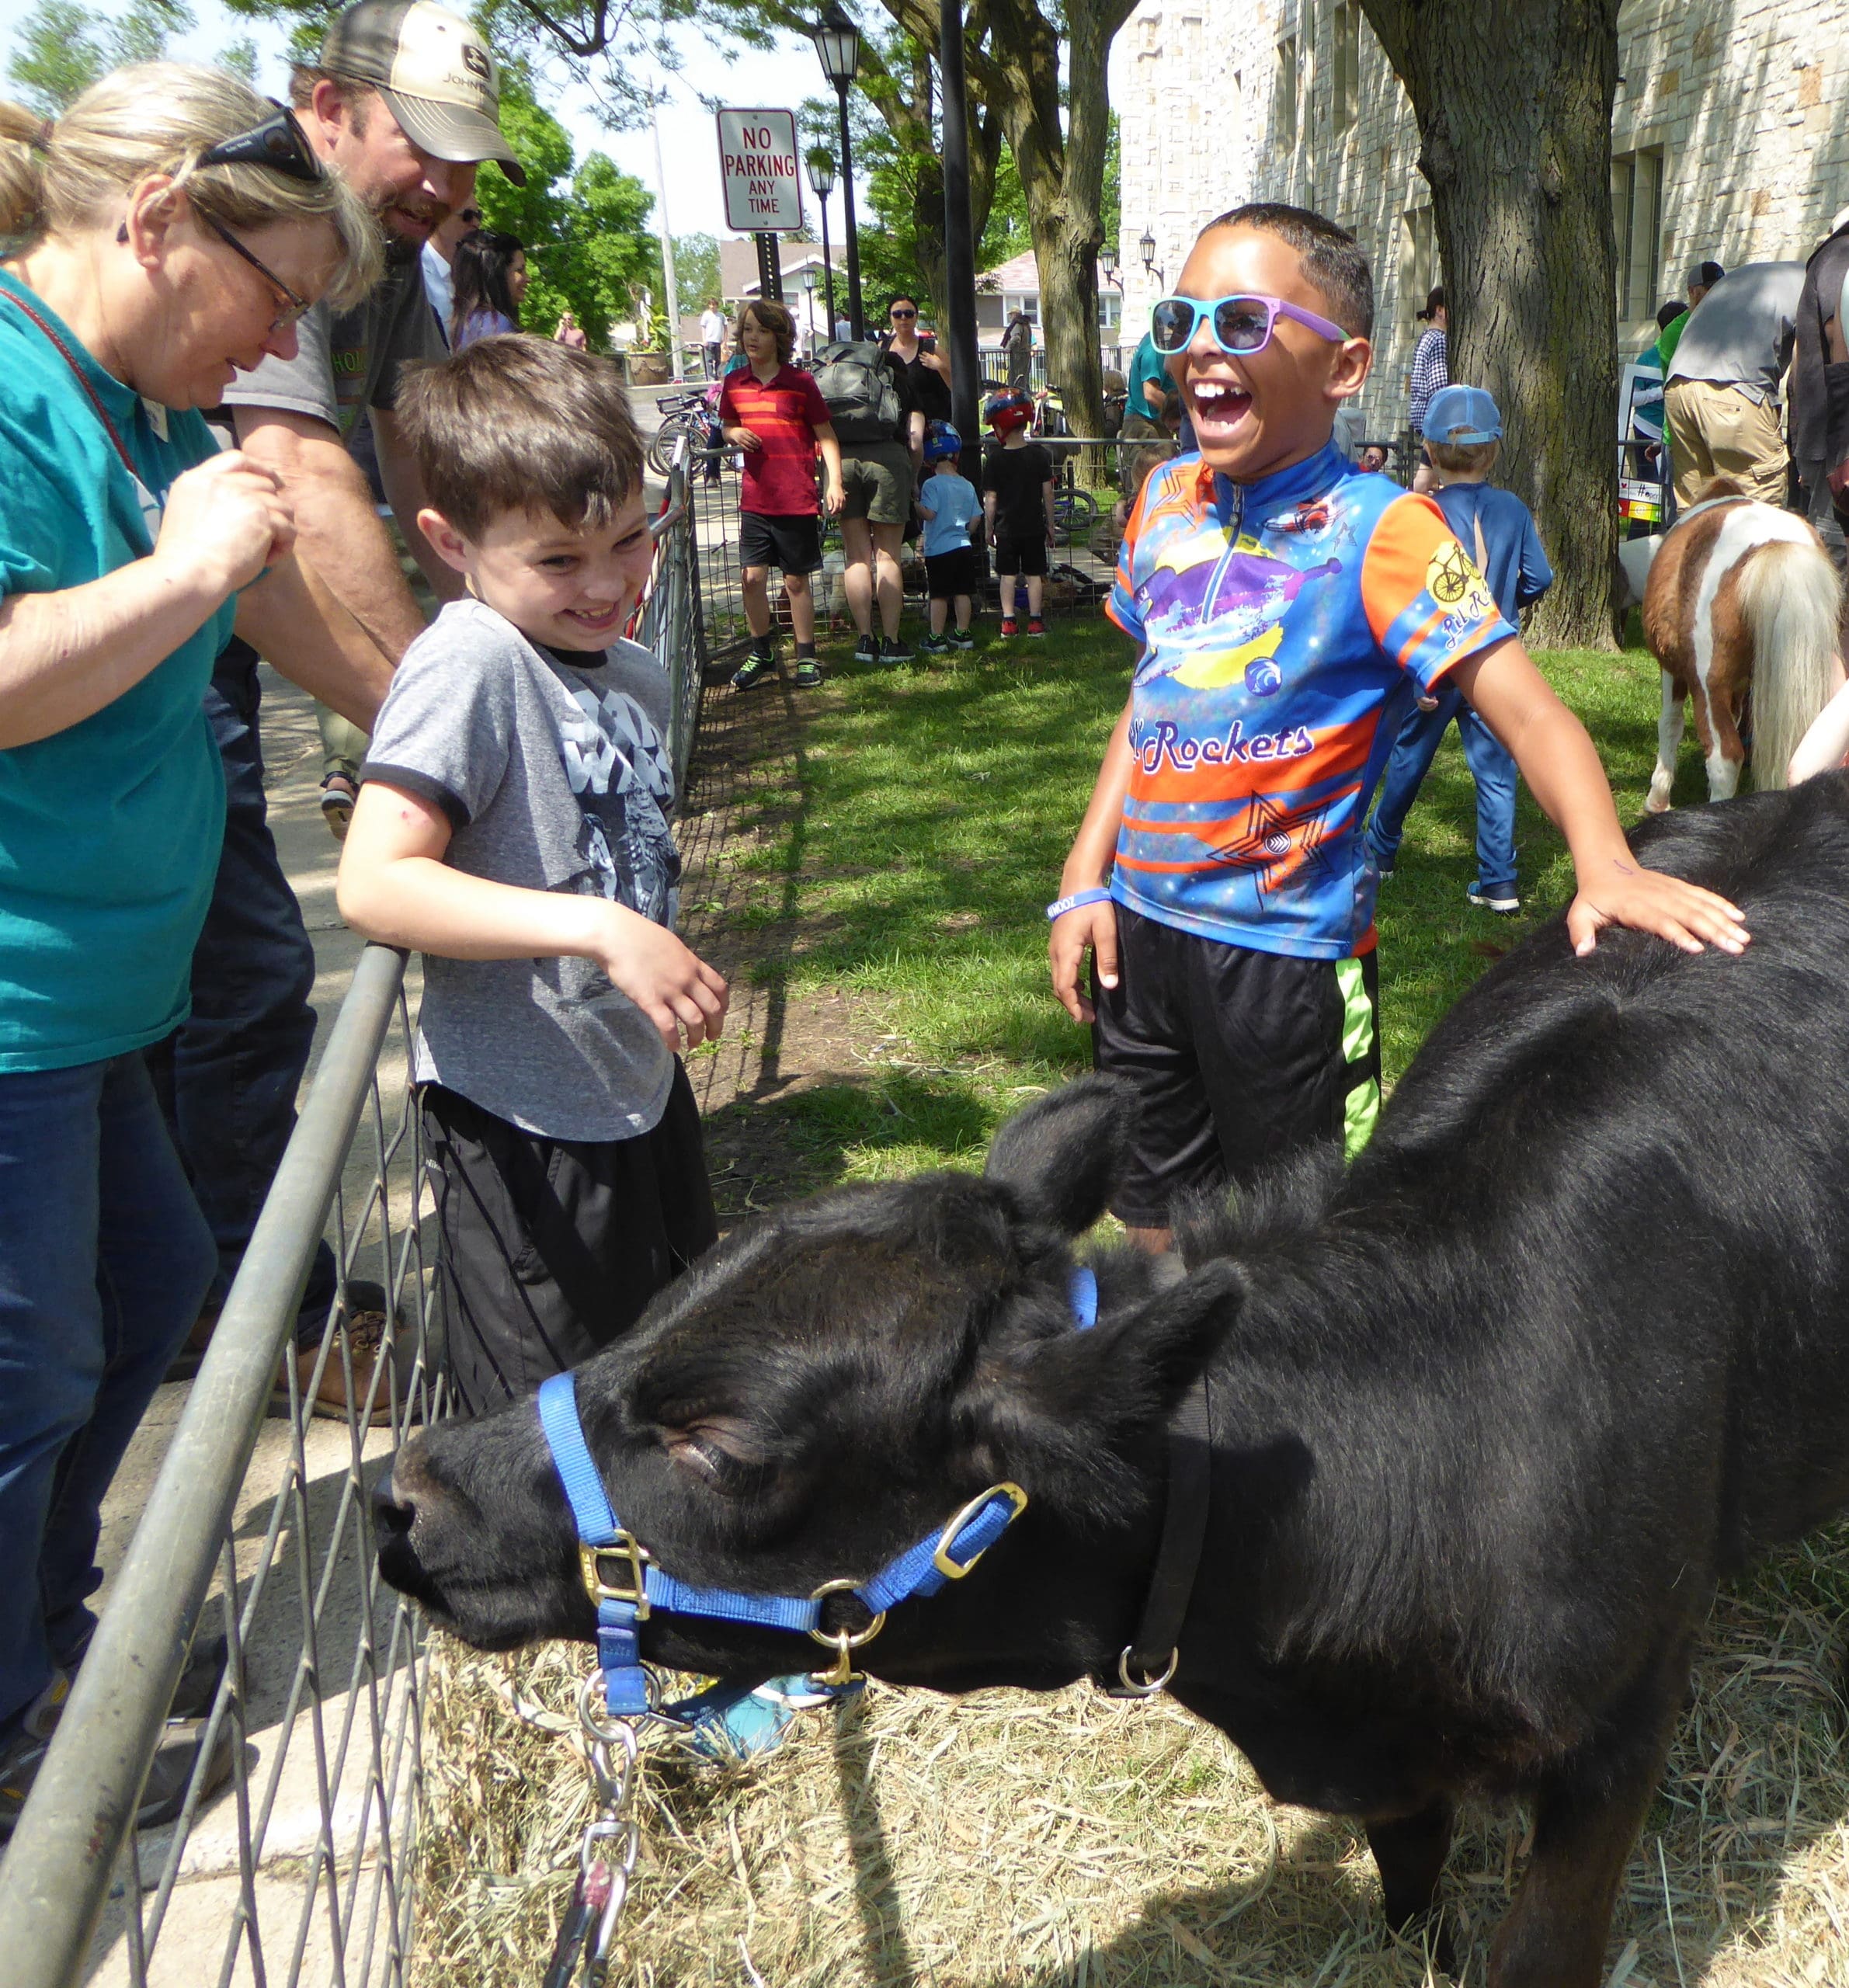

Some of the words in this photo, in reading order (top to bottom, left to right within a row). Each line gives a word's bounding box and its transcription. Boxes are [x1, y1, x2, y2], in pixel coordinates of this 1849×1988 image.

[742, 127, 771, 150] NO
[725, 155, 794, 177] PARKING
[749, 180, 775, 196] ANY
[748, 199, 780, 214] TIME
[1143, 719, 1315, 774] Rockets
